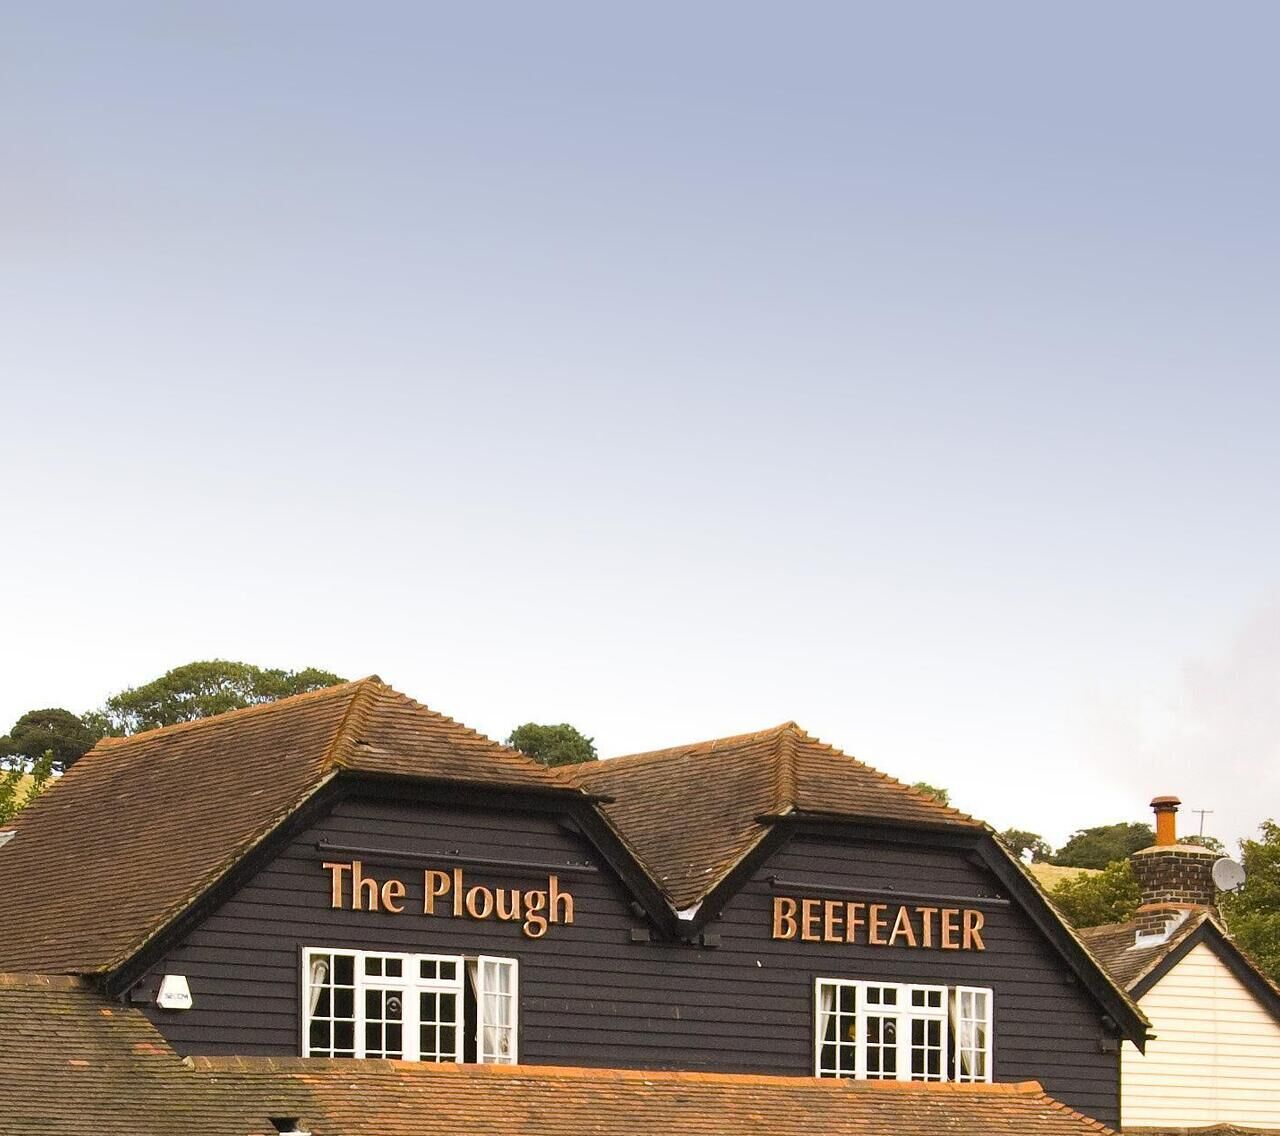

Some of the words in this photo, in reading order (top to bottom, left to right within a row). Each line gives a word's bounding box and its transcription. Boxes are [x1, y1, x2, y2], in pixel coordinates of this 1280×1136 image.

[322, 860, 406, 913] The
[423, 867, 574, 938] Plough
[772, 896, 986, 950] BEEFEATER
